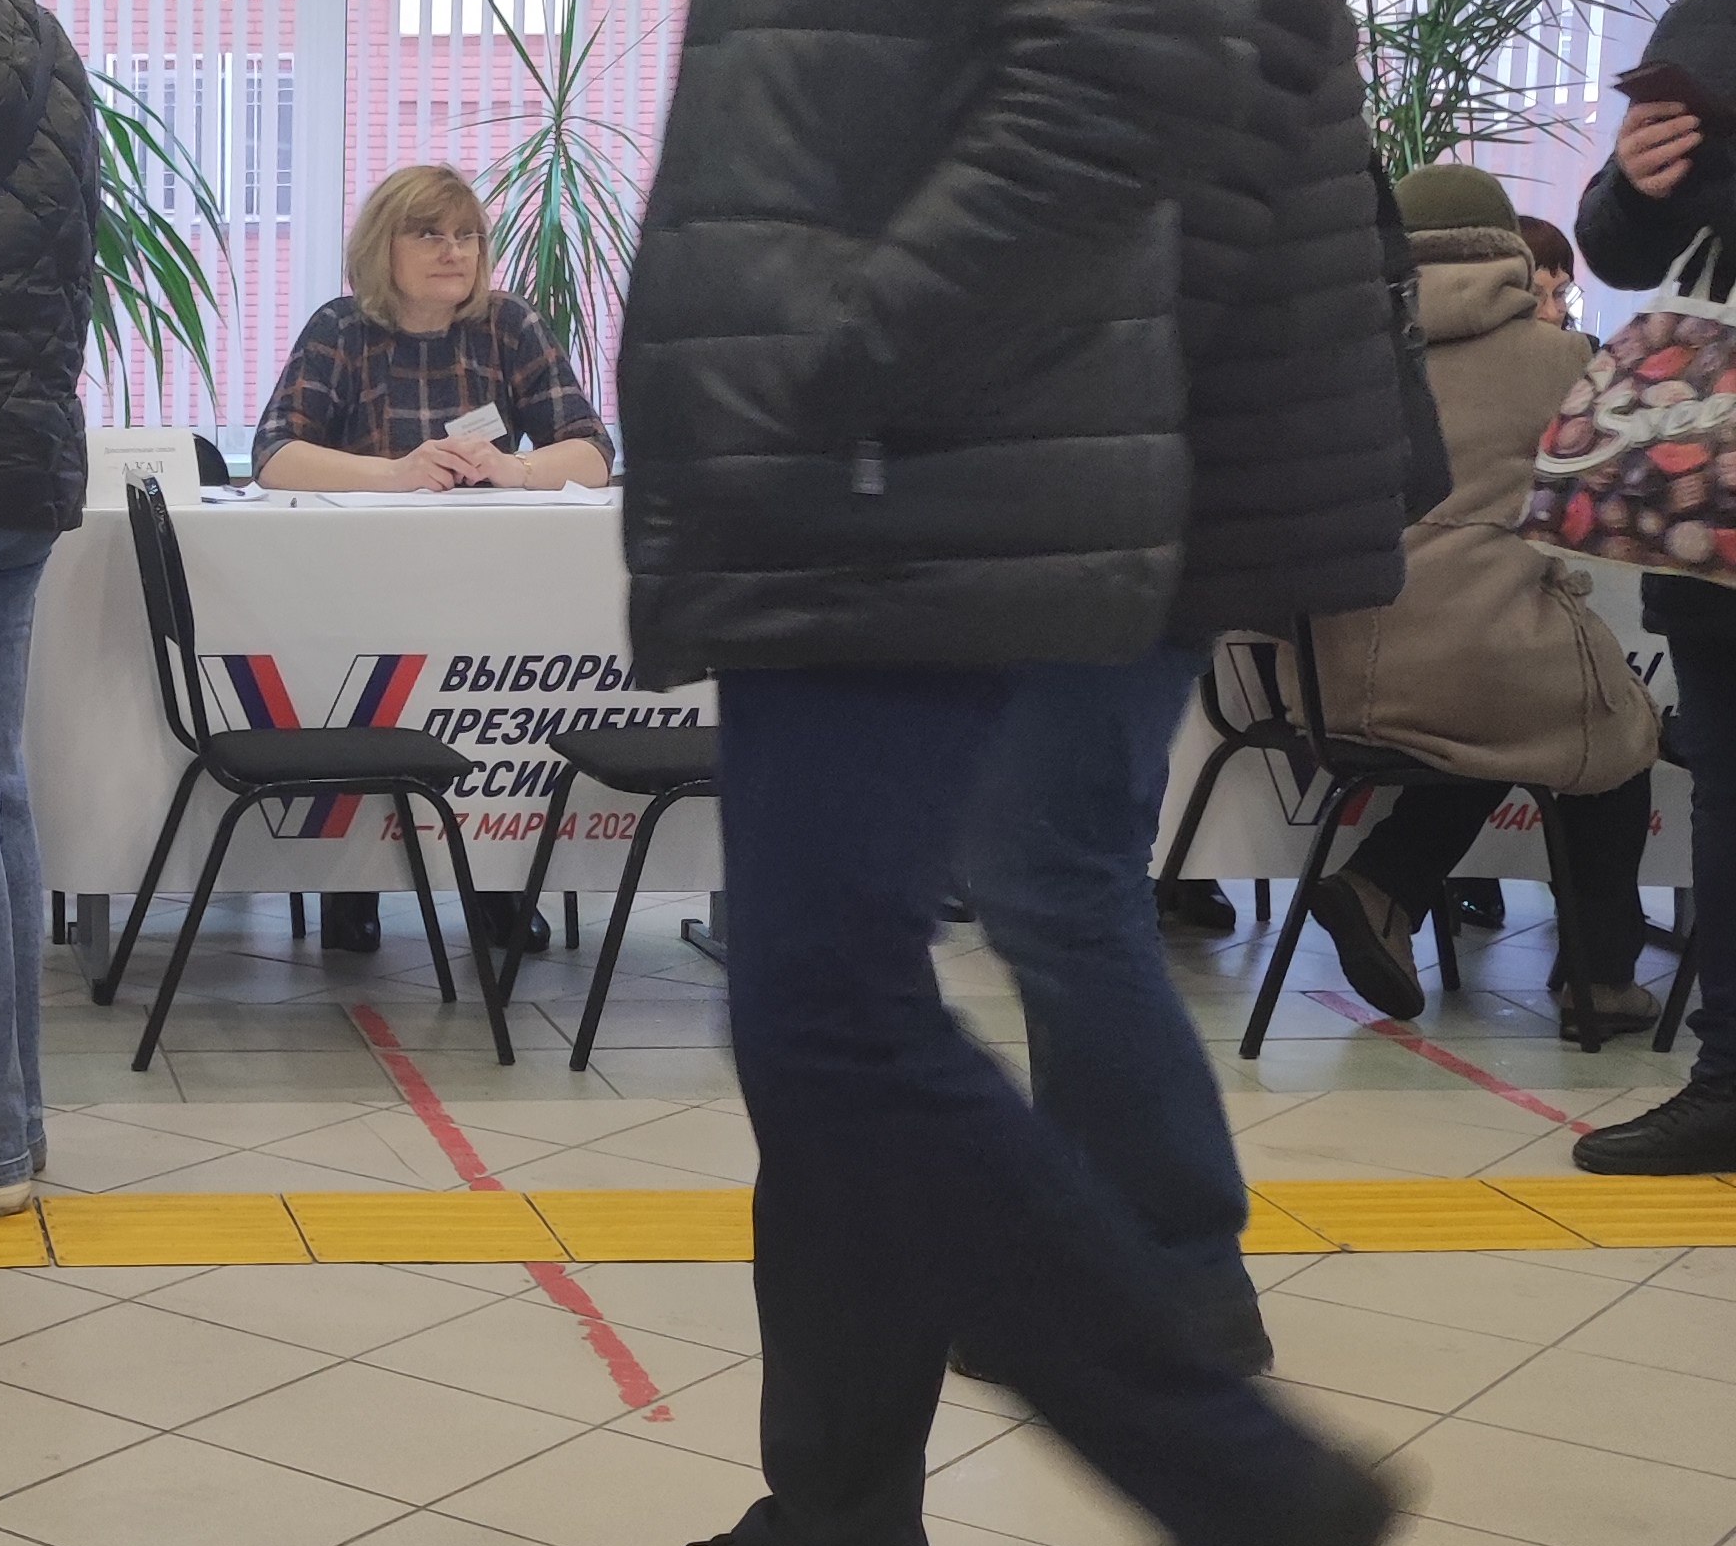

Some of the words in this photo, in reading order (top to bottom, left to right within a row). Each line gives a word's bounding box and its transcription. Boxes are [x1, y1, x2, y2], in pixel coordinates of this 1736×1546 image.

[439, 655, 635, 692] ВЫБОРЫ
[473, 812, 577, 841] МАРА
[585, 812, 637, 841] 202
